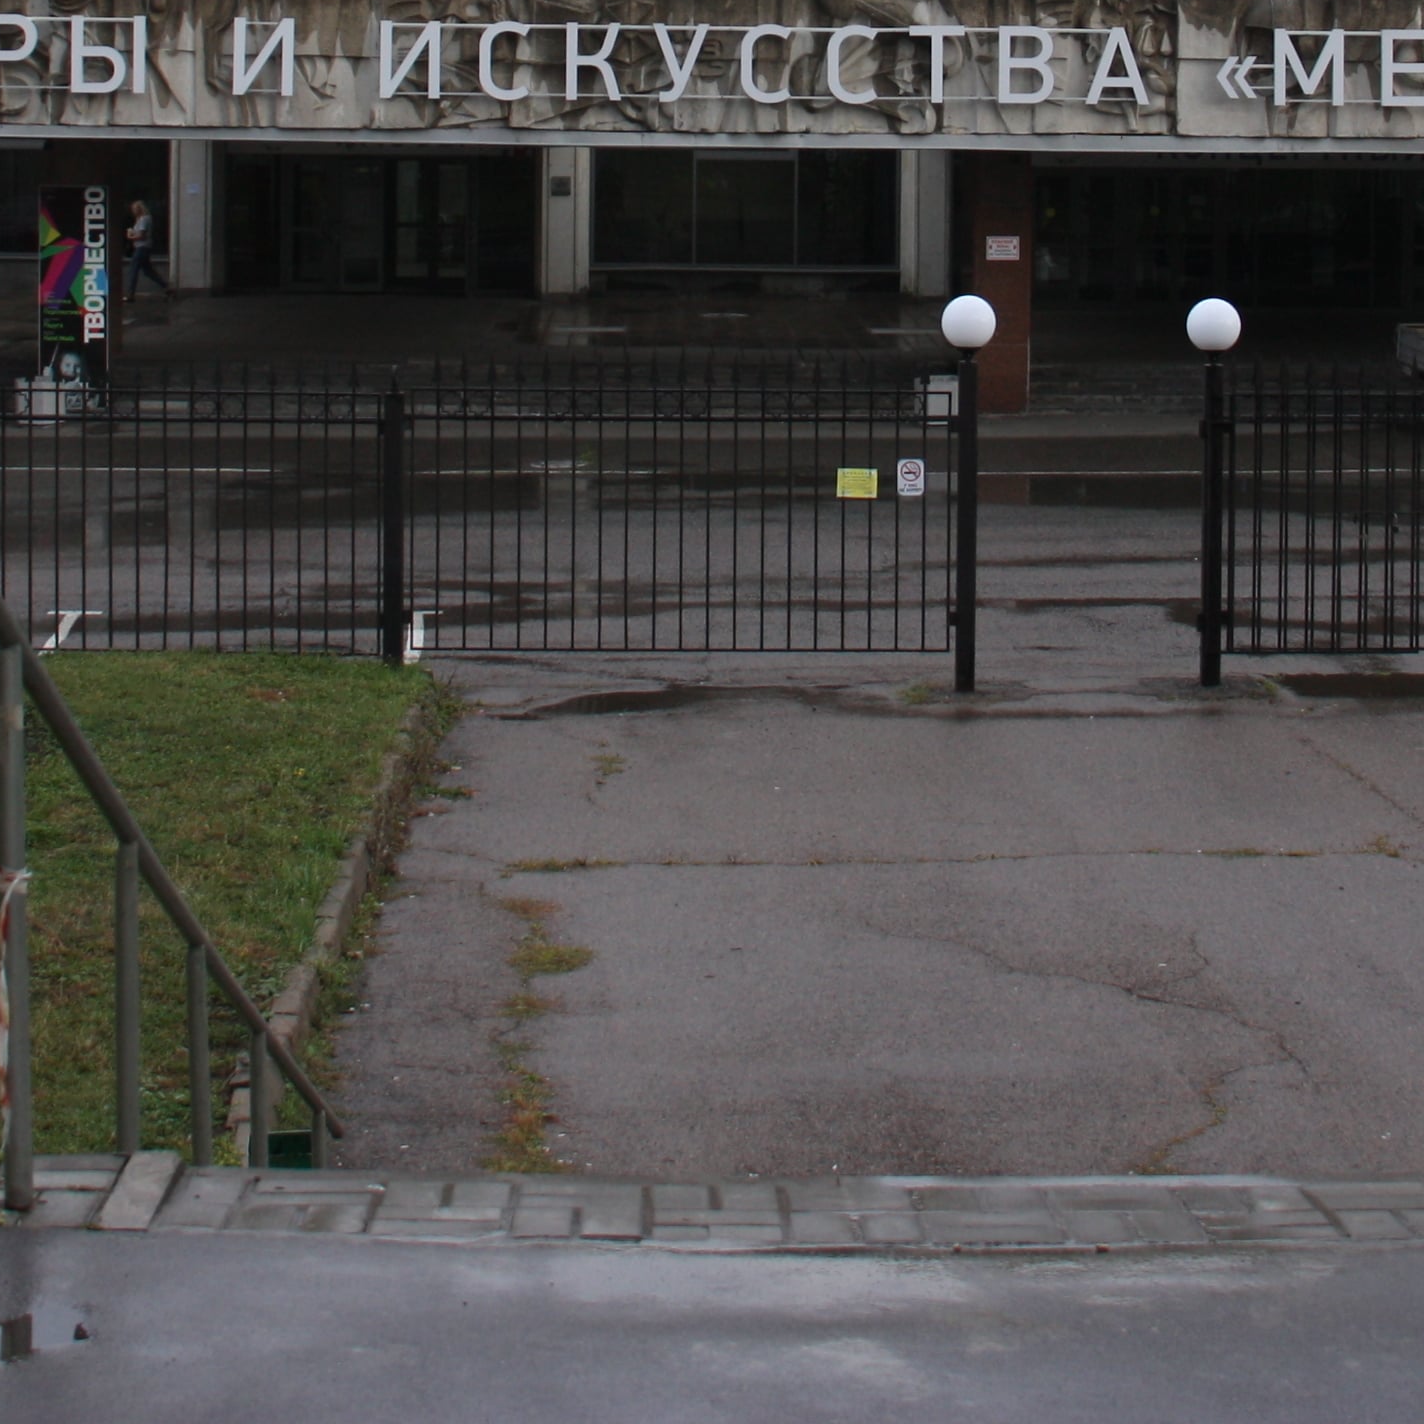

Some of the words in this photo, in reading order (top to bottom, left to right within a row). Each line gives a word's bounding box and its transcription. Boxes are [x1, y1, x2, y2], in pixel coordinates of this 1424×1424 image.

[232, 17, 295, 98] И
[379, 20, 1150, 107] ИСКУССТВА
[84, 186, 105, 344] ТВОРЧЕСТВО
